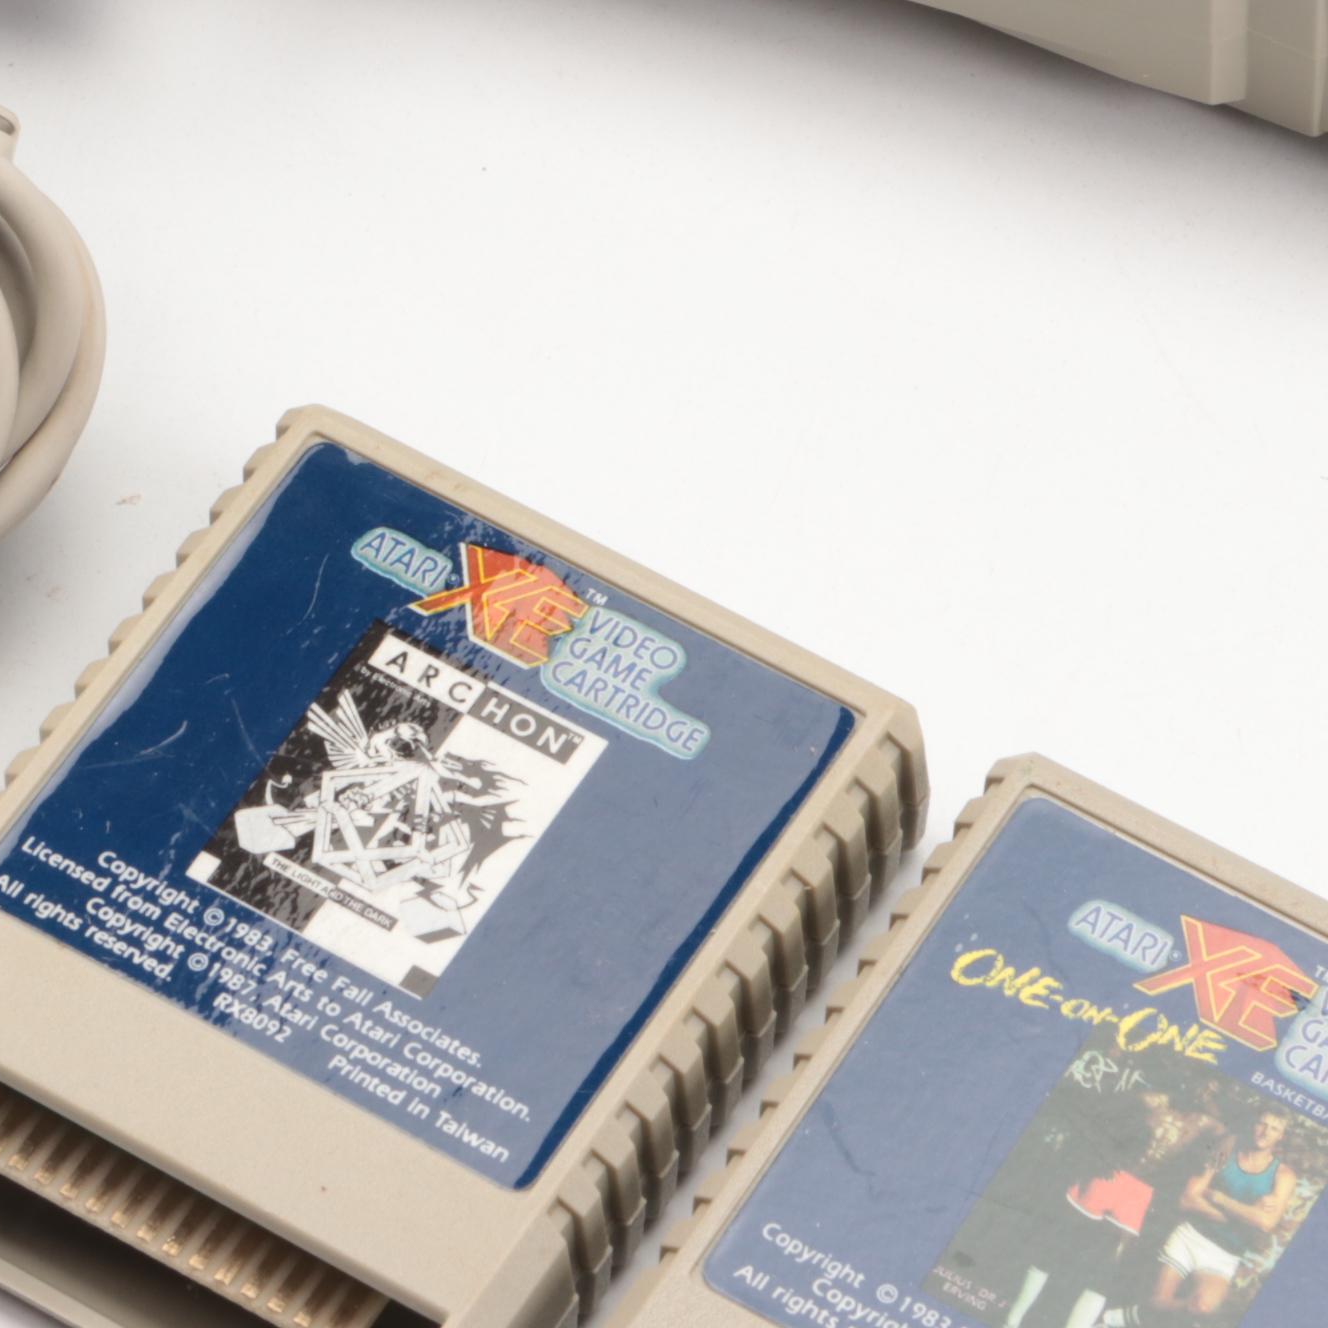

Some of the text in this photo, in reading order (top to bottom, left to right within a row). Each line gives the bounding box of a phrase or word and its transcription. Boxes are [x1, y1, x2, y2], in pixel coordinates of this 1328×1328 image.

[569, 637, 654, 692] GAME
[589, 609, 678, 670] VIDEO
[552, 661, 705, 752] CARTRIDGE
[272, 858, 290, 873] THE
[292, 869, 320, 891] LIGHT
[343, 896, 365, 913] THE
[364, 904, 392, 927] DARK
[24, 888, 84, 931] rights
[84, 924, 172, 982] reserved.
[97, 851, 200, 914] Copyright
[280, 948, 329, 983] Free
[331, 976, 374, 1006] Fall
[373, 1000, 481, 1069] Associates.
[22, 835, 531, 1123] Licensed from Electronic Arts to Atari Corporation.
[85, 897, 185, 960] Copyright
[263, 994, 320, 1031] Atari
[320, 1024, 442, 1099] Corporation
[212, 992, 293, 1043] RX8092
[328, 1054, 510, 1163] Printed in Taiwan
[761, 1222, 865, 1289] Copyright
[733, 1264, 840, 1328] All rights
